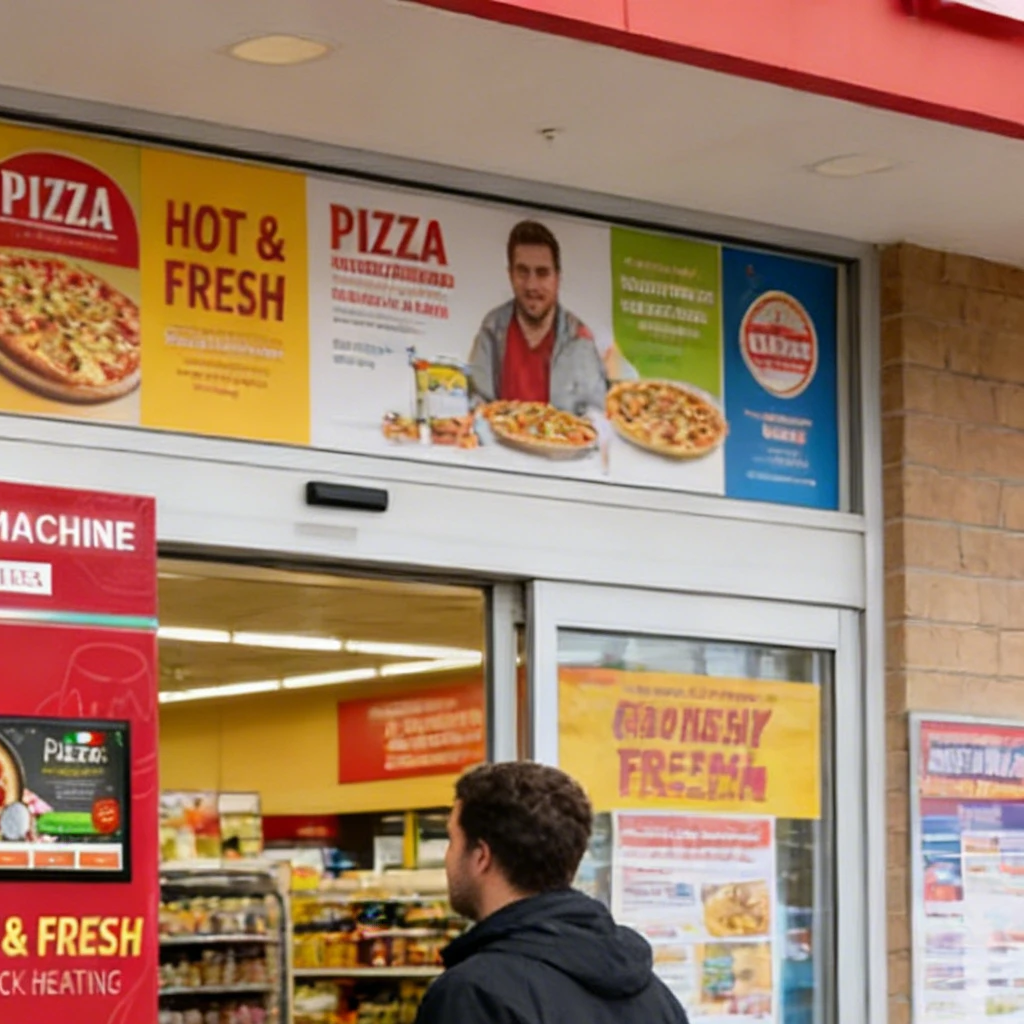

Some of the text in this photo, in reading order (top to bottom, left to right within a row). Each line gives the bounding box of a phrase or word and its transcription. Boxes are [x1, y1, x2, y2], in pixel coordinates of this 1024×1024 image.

[0, 170, 113, 231] PIZZA
[166, 199, 247, 255] HOT
[256, 215, 286, 262] &
[329, 203, 448, 266] PIZZA
[164, 260, 286, 322] FRESH
[1, 915, 29, 958] &
[37, 916, 144, 957] FRESH
[32, 969, 122, 996] HEATING
